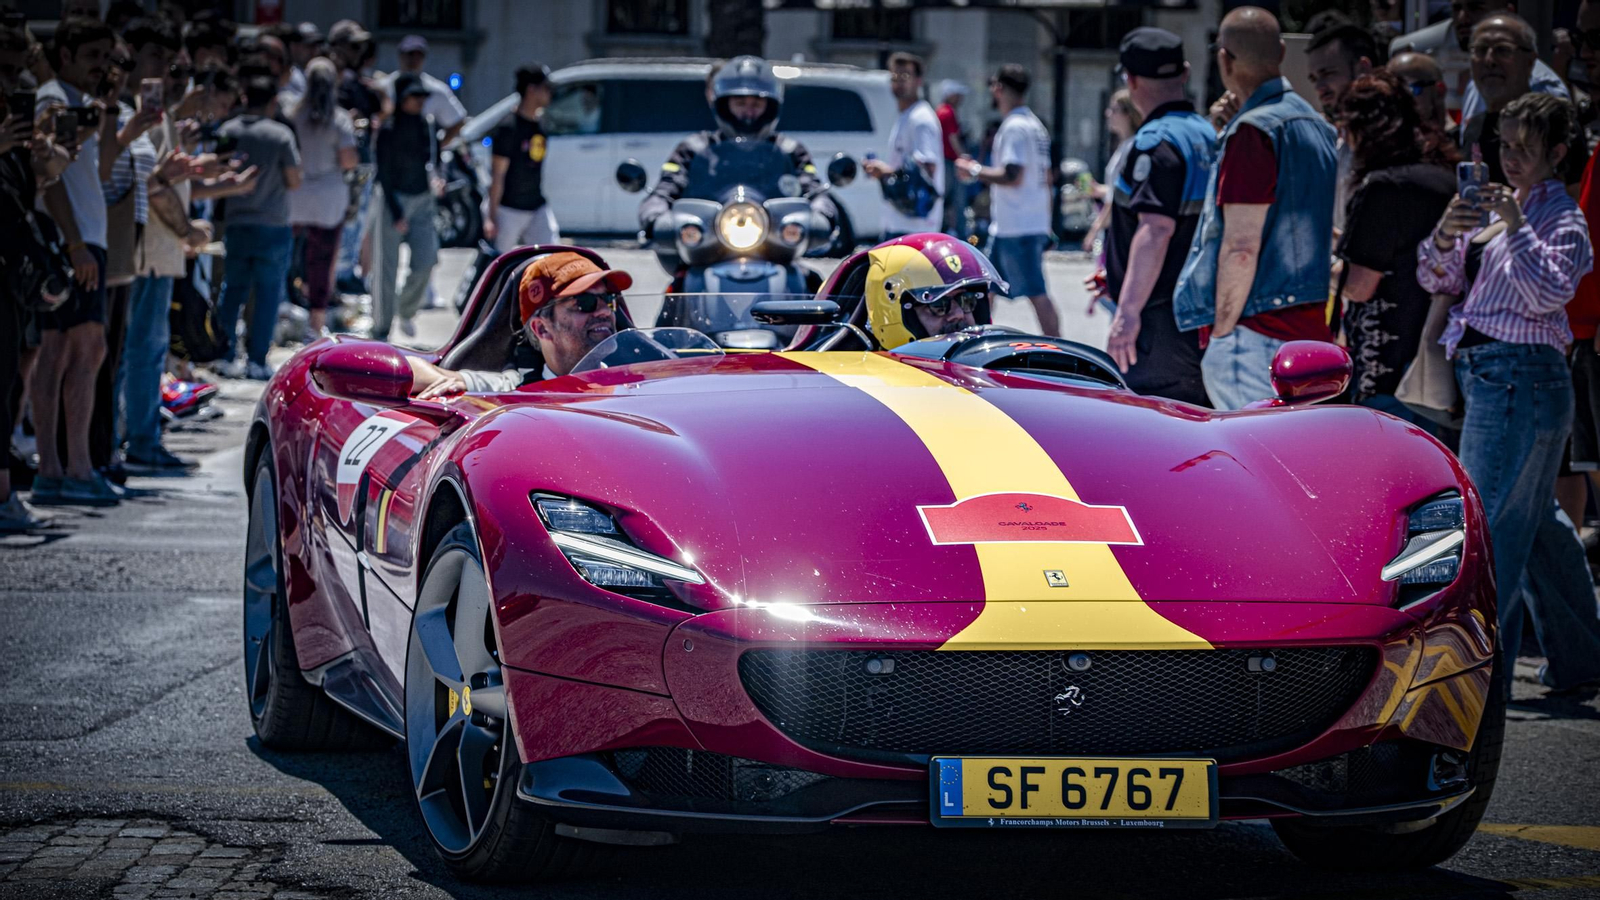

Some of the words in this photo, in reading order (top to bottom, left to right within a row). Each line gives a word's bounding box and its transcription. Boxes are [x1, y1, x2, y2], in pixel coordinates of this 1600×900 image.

[530, 286, 541, 298] 22
[1008, 342, 1063, 352] 22
[344, 425, 388, 465] 22
[987, 766, 1046, 810] SF
[1061, 767, 1184, 811] 6767
[944, 791, 954, 807] L
[1000, 818, 1054, 827] Francorchamps
[1055, 818, 1080, 826] Motors
[1081, 818, 1110, 826] Brussels
[1120, 819, 1164, 828] Luxembourg
